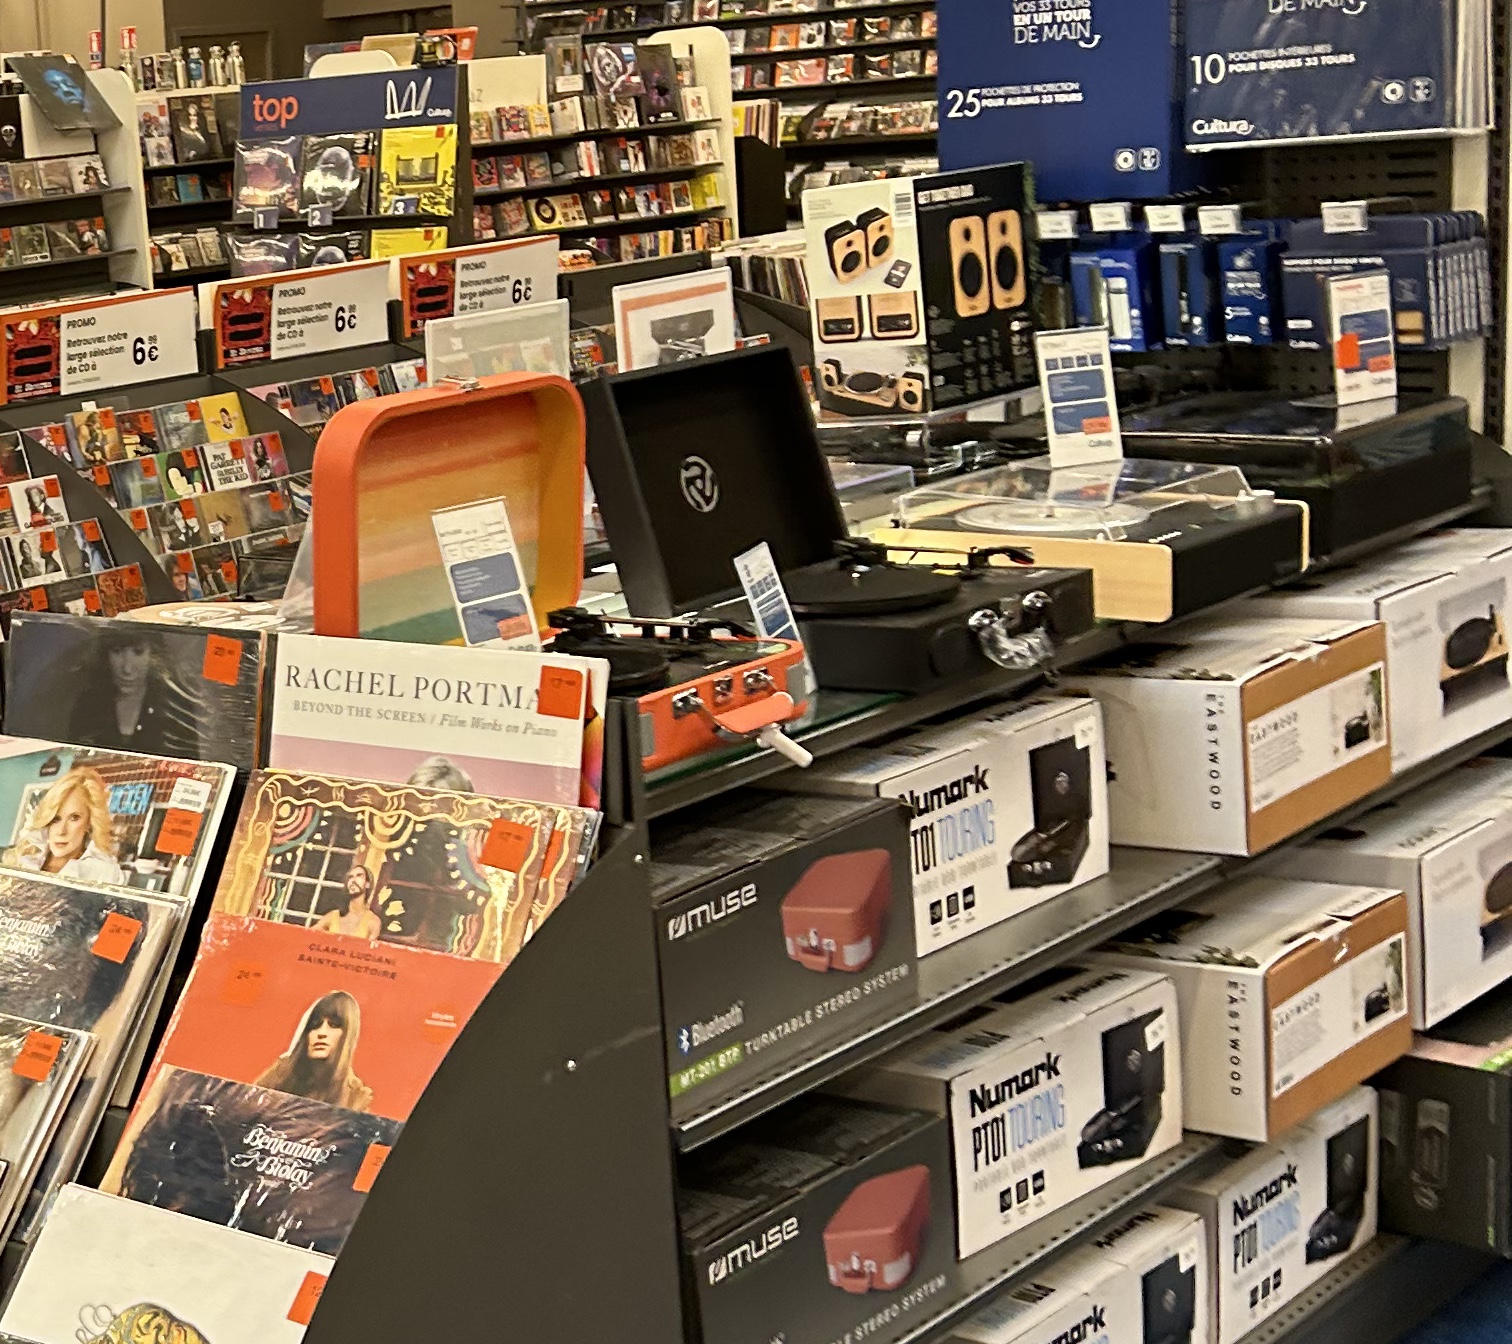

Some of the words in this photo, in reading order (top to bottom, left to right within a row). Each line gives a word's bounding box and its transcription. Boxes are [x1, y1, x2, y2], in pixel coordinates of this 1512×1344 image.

[1013, 14, 1031, 25] EN
[1034, 13, 1053, 24] UN
[1054, 9, 1091, 22] TOUR
[1014, 0, 1036, 13] VOS
[1038, 0, 1052, 11] 33
[1014, 26, 1038, 44] DE
[1042, 22, 1091, 42] MAIN
[1191, 54, 1226, 84] 10
[1228, 62, 1257, 73] POUR
[253, 94, 299, 128] top
[946, 88, 981, 118] 25
[1193, 119, 1255, 136] Cultura
[256, 213, 265, 228] 1
[312, 211, 321, 226] 2
[395, 202, 405, 215] 3
[278, 287, 306, 298] PROMO
[512, 279, 522, 304] 6
[66, 317, 96, 329] PROMO
[335, 306, 346, 332] 6
[133, 337, 145, 365] 6
[285, 665, 404, 699] RACHEL
[293, 700, 343, 716] BEYOND
[346, 705, 372, 719] THE
[377, 708, 427, 725] SCREEN
[439, 714, 467, 729] Film
[471, 717, 503, 733] Works
[505, 723, 519, 733] on
[522, 722, 558, 738] Piano
[1206, 693, 1223, 811] EASTWOOD
[898, 764, 990, 820] Numark
[937, 799, 995, 864] TOURING
[687, 882, 758, 933] muse
[308, 943, 346, 956] CLARA
[298, 954, 398, 980] SAINTE-VICTOIRE
[863, 963, 909, 995] SYSTEM
[745, 1009, 814, 1055] TURNTABLE
[815, 987, 861, 1019] STEREO
[1227, 980, 1242, 1096] EASTWOOD
[969, 1052, 1061, 1117] Numark
[973, 1111, 1007, 1173] PT01
[1008, 1083, 1066, 1152] TOURING
[243, 1126, 336, 1164] Benjamin
[240, 1152, 314, 1189] Biolay
[1233, 1163, 1299, 1226] Numark
[728, 1216, 800, 1273] muse
[1234, 1214, 1259, 1274] PT01
[854, 1303, 900, 1341] STEREO
